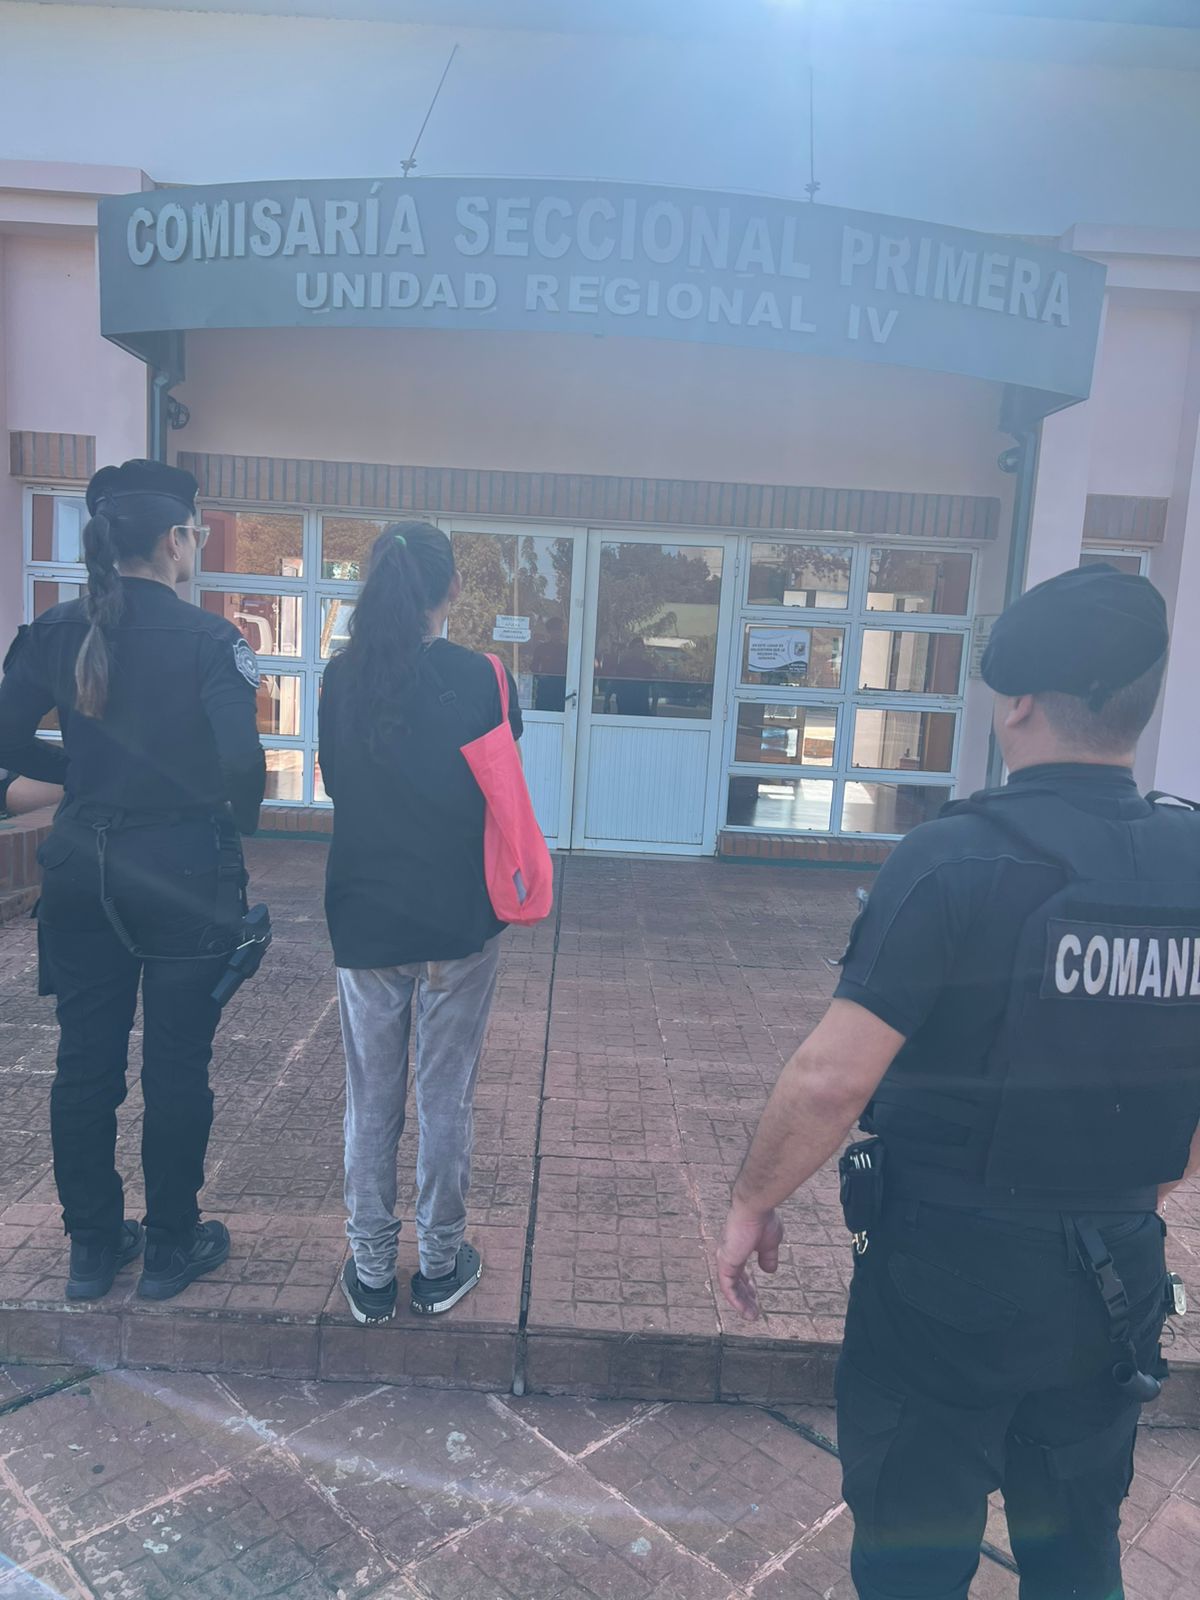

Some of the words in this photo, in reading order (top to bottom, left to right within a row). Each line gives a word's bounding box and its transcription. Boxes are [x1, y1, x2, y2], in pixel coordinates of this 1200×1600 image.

[126, 181, 426, 266] COMISARÍA
[454, 195, 811, 280] SECCIONAL
[839, 225, 1071, 327] PRIMERA
[296, 271, 497, 310] UNIDAD
[525, 273, 817, 334] REGIONAL
[847, 303, 899, 344] IV
